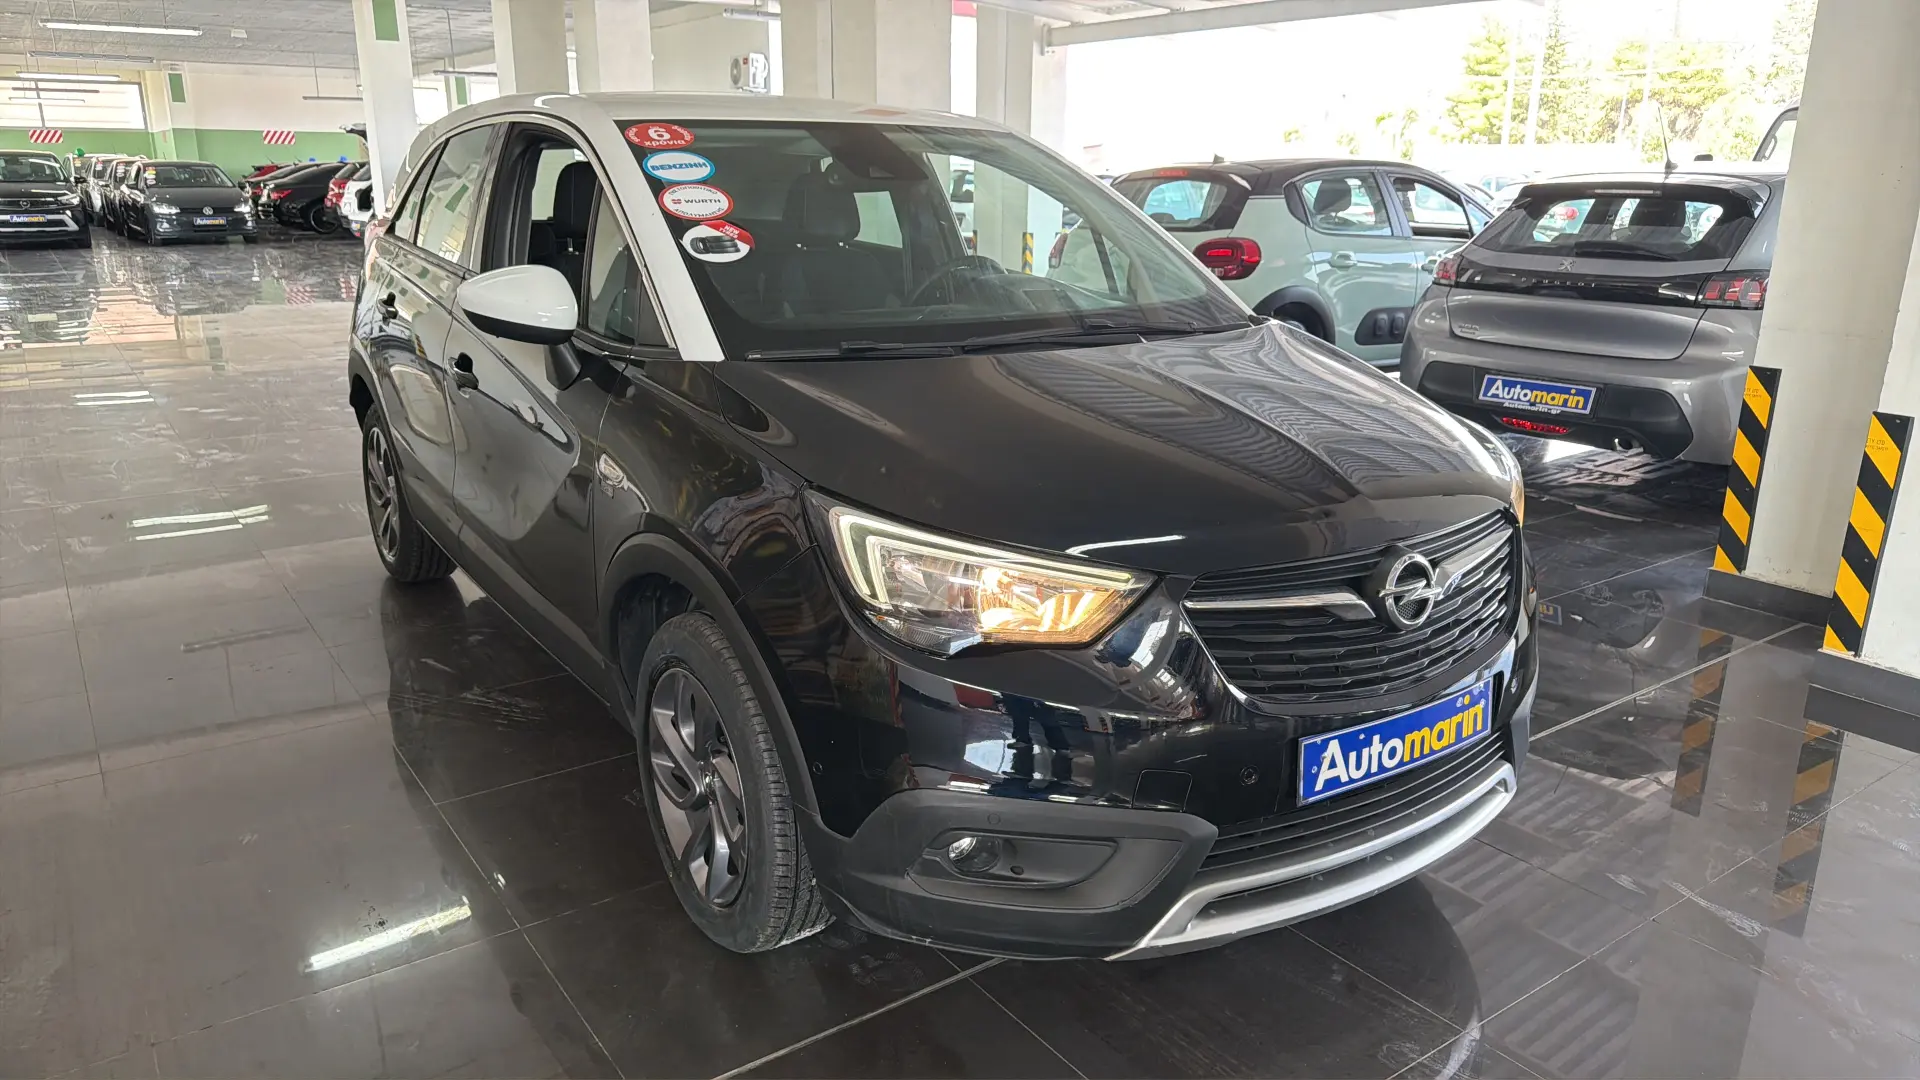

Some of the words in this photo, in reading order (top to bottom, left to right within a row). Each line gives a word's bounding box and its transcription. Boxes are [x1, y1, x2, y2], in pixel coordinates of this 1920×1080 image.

[648, 128, 671, 140] 6
[723, 225, 740, 235] NEW
[1521, 277, 1596, 288] PEUGEOT
[1487, 379, 1584, 409] Automarin
[1314, 694, 1484, 792] Automarin
